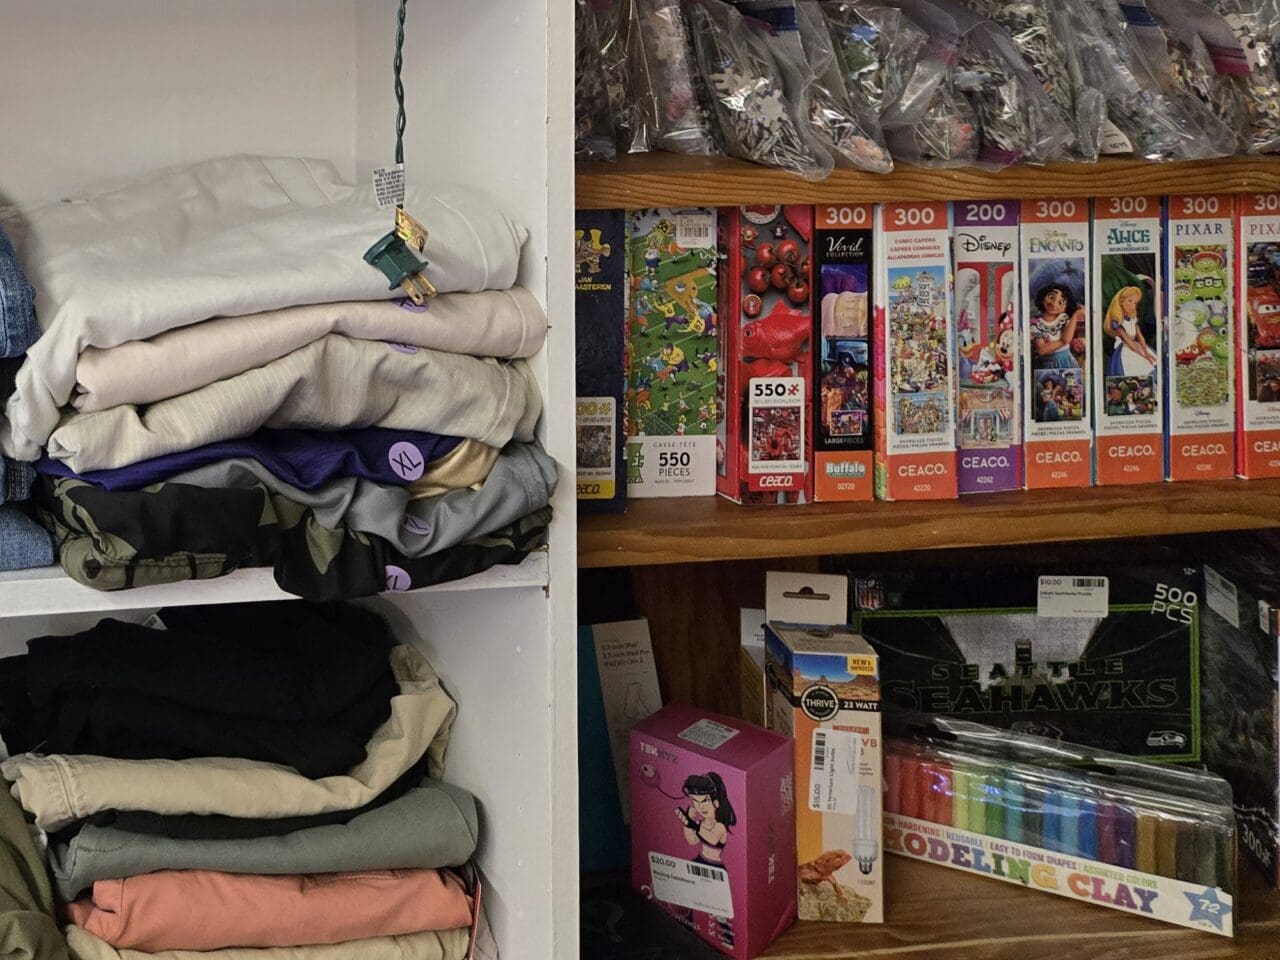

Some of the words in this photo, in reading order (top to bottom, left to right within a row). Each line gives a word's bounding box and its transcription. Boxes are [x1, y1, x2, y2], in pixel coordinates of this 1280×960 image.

[1036, 201, 1076, 218] 300
[1109, 196, 1148, 214] 300
[1182, 197, 1219, 214] 300
[1254, 194, 1280, 211] 30
[826, 207, 867, 225] 300
[894, 207, 935, 225] 300
[966, 204, 1006, 221] 200
[1106, 228, 1151, 245] ALICE
[1176, 223, 1224, 236] PIXAR
[826, 237, 865, 253] Vivid
[958, 233, 1012, 257] Disney
[1029, 237, 1084, 253] ENCANTO
[576, 283, 612, 291] AASTEREN
[754, 383, 786, 396] 550
[1035, 451, 1080, 464] CEACO
[1108, 444, 1153, 458] CEACO
[1181, 444, 1225, 457] CEACO
[392, 450, 422, 476] XL
[659, 452, 690, 467] 550
[962, 456, 1008, 468] CEACO
[658, 467, 691, 477] PIECES
[826, 461, 866, 477] Buffalo
[898, 463, 945, 477] CEACO
[759, 475, 793, 487] ceaco
[1154, 582, 1198, 607] 500
[1150, 599, 1194, 625] PCS
[852, 658, 867, 666] NEW
[930, 658, 1124, 681] SEATTLE
[805, 698, 835, 708] THRIVE
[881, 678, 1182, 715] SEAHAWKS
[855, 701, 878, 710] WATT
[861, 738, 877, 748] VB
[813, 783, 821, 808] $15.00
[650, 855, 676, 868] $20.00
[883, 817, 941, 838] ON-HARDENING
[946, 831, 984, 848] REUSABLE
[989, 842, 1009, 856] EASY
[1011, 847, 1021, 858] TO
[1022, 850, 1045, 863] FORM
[1046, 854, 1077, 871] SHAPES
[1126, 872, 1158, 890] COLORS
[883, 827, 1058, 889] MODELING
[1067, 872, 1160, 914] CLAY
[1199, 898, 1220, 914] 72
